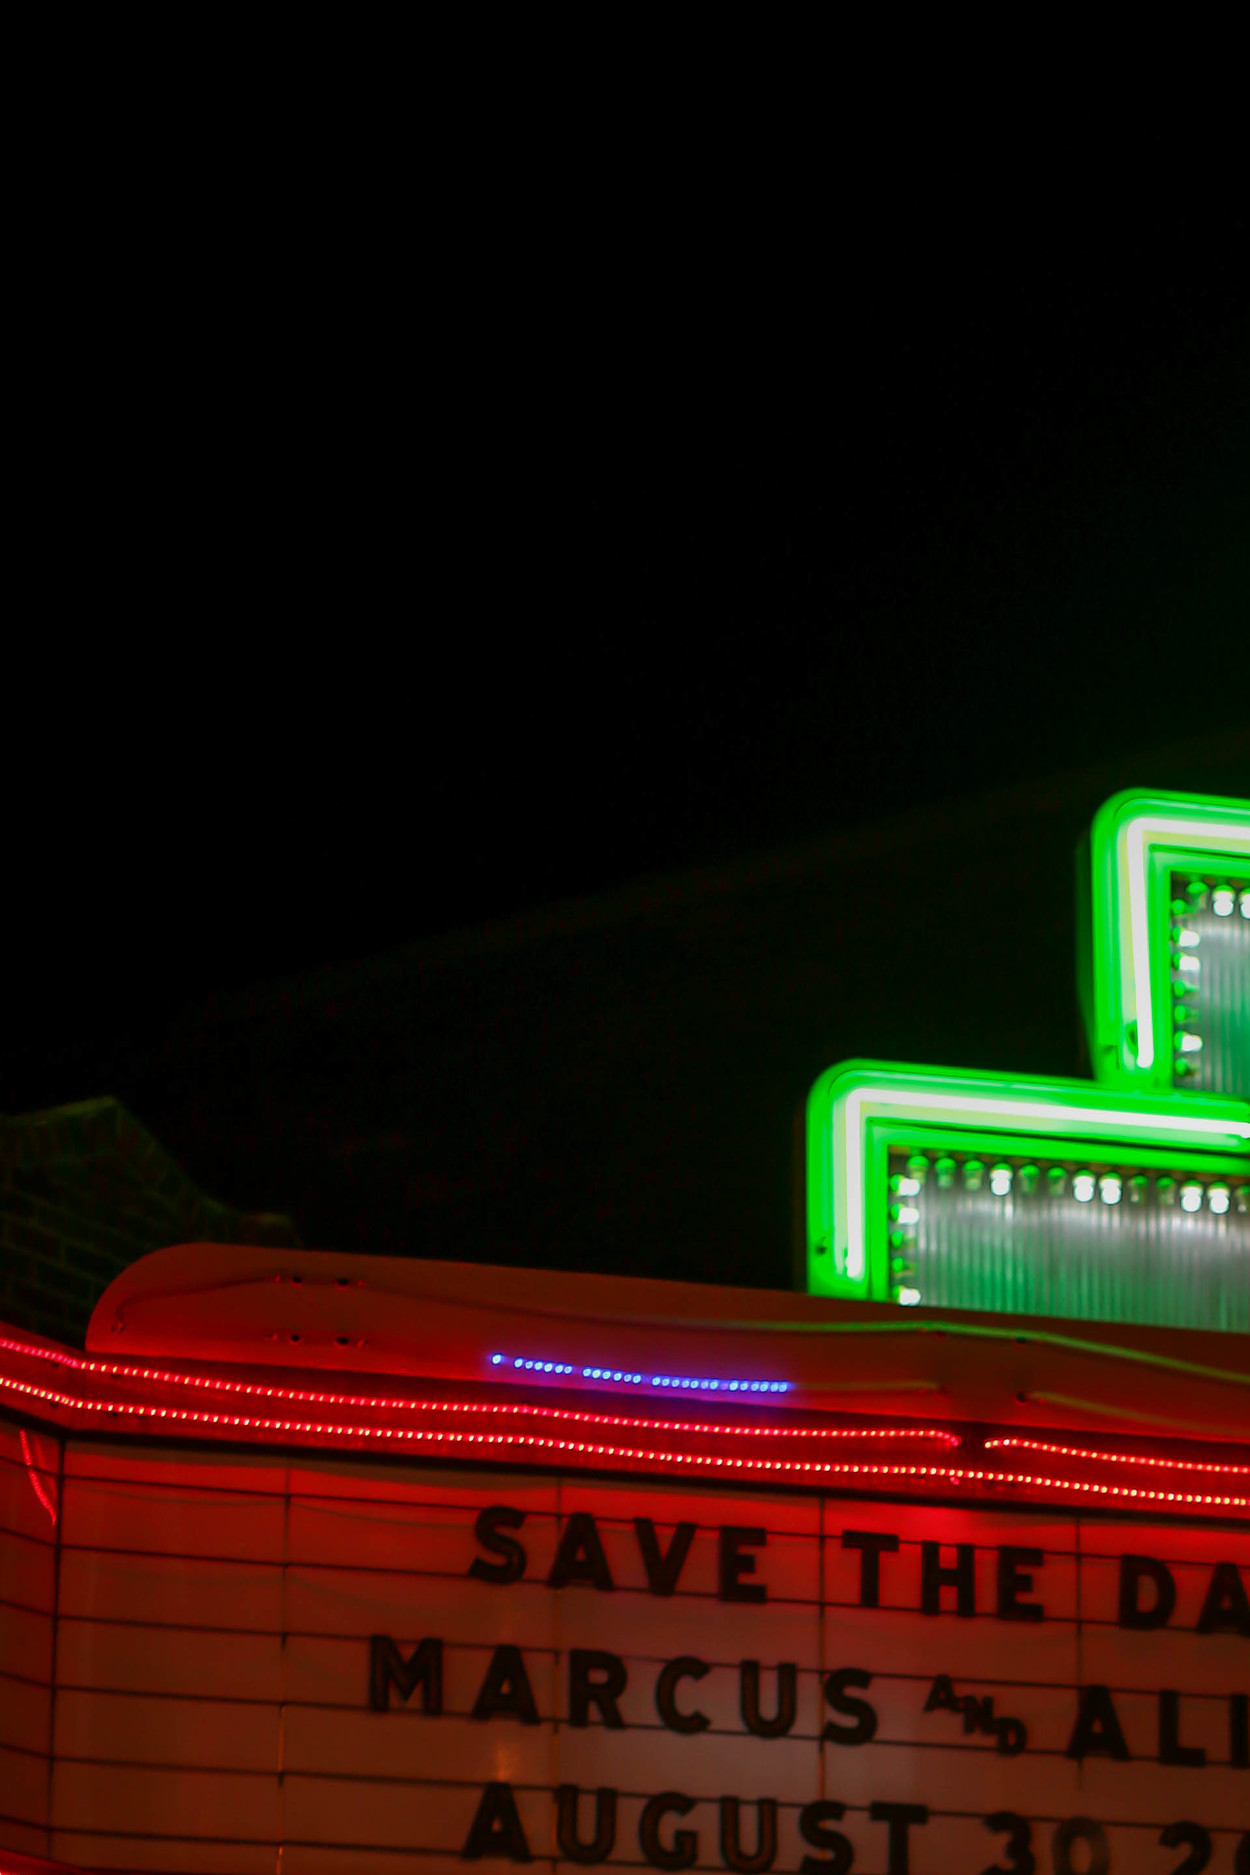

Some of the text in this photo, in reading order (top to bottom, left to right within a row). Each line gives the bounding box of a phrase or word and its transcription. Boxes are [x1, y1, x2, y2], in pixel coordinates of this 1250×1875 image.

[468, 1506, 767, 1602] SAVE
[842, 1529, 1045, 1622] THE
[368, 1634, 877, 1744] MARCUS
[923, 1674, 1027, 1755] AND
